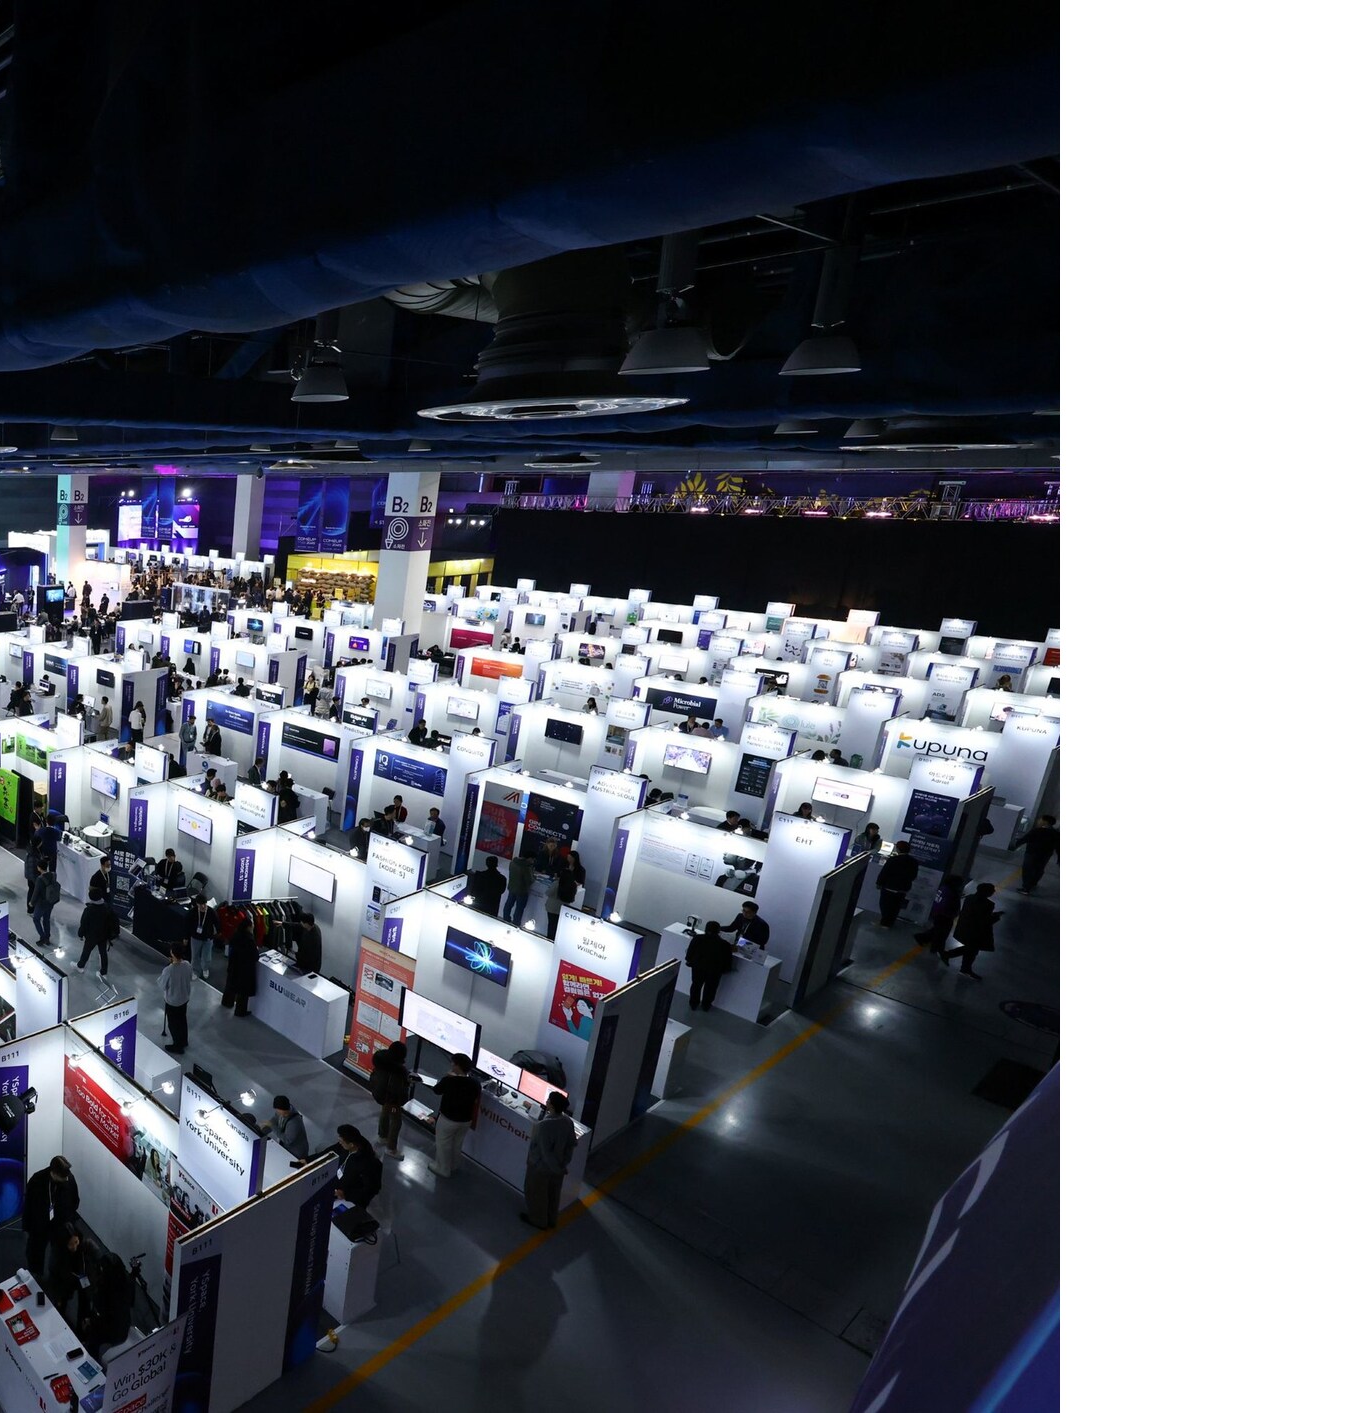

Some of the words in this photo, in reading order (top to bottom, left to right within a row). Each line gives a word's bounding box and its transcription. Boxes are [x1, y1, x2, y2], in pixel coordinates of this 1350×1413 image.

[60, 490, 68, 500] B2
[74, 490, 84, 501] B2
[392, 496, 409, 513] B2
[420, 496, 433, 513] B2
[673, 697, 702, 707] Microbial
[673, 703, 689, 711] Power
[1016, 725, 1047, 735] KUPUNA
[591, 785, 616, 797] AUSTRIA
[617, 792, 636, 802] SEOUL
[527, 823, 567, 841] CONNECTS
[820, 828, 840, 836] Taiwan
[795, 836, 813, 846] EHT
[372, 853, 398, 869] FASHION
[398, 861, 415, 874] KODE
[564, 911, 581, 922] C101
[577, 944, 607, 961] WillChair
[582, 936, 606, 952] 윌체어
[27, 973, 47, 995] Rangle
[113, 1009, 130, 1020] B116
[1, 1050, 19, 1062] B111
[186, 1085, 202, 1101] B111
[74, 1084, 85, 1099] Too
[84, 1091, 97, 1109] Bold
[105, 1113, 120, 1131] Just
[88, 1107, 101, 1121] One
[100, 1115, 119, 1140] Market
[226, 1118, 250, 1142] Canada
[478, 1105, 531, 1142] WillChair
[185, 1118, 202, 1138] York
[202, 1133, 245, 1176] University
[192, 1238, 212, 1255] B111
[188, 1276, 199, 1303] York
[198, 1268, 211, 1312] YSpace,
[183, 1304, 197, 1355] University
[114, 1369, 136, 1390] Win
[138, 1352, 167, 1376] $30K
[112, 1388, 129, 1402] Go
[131, 1366, 166, 1392] Global
